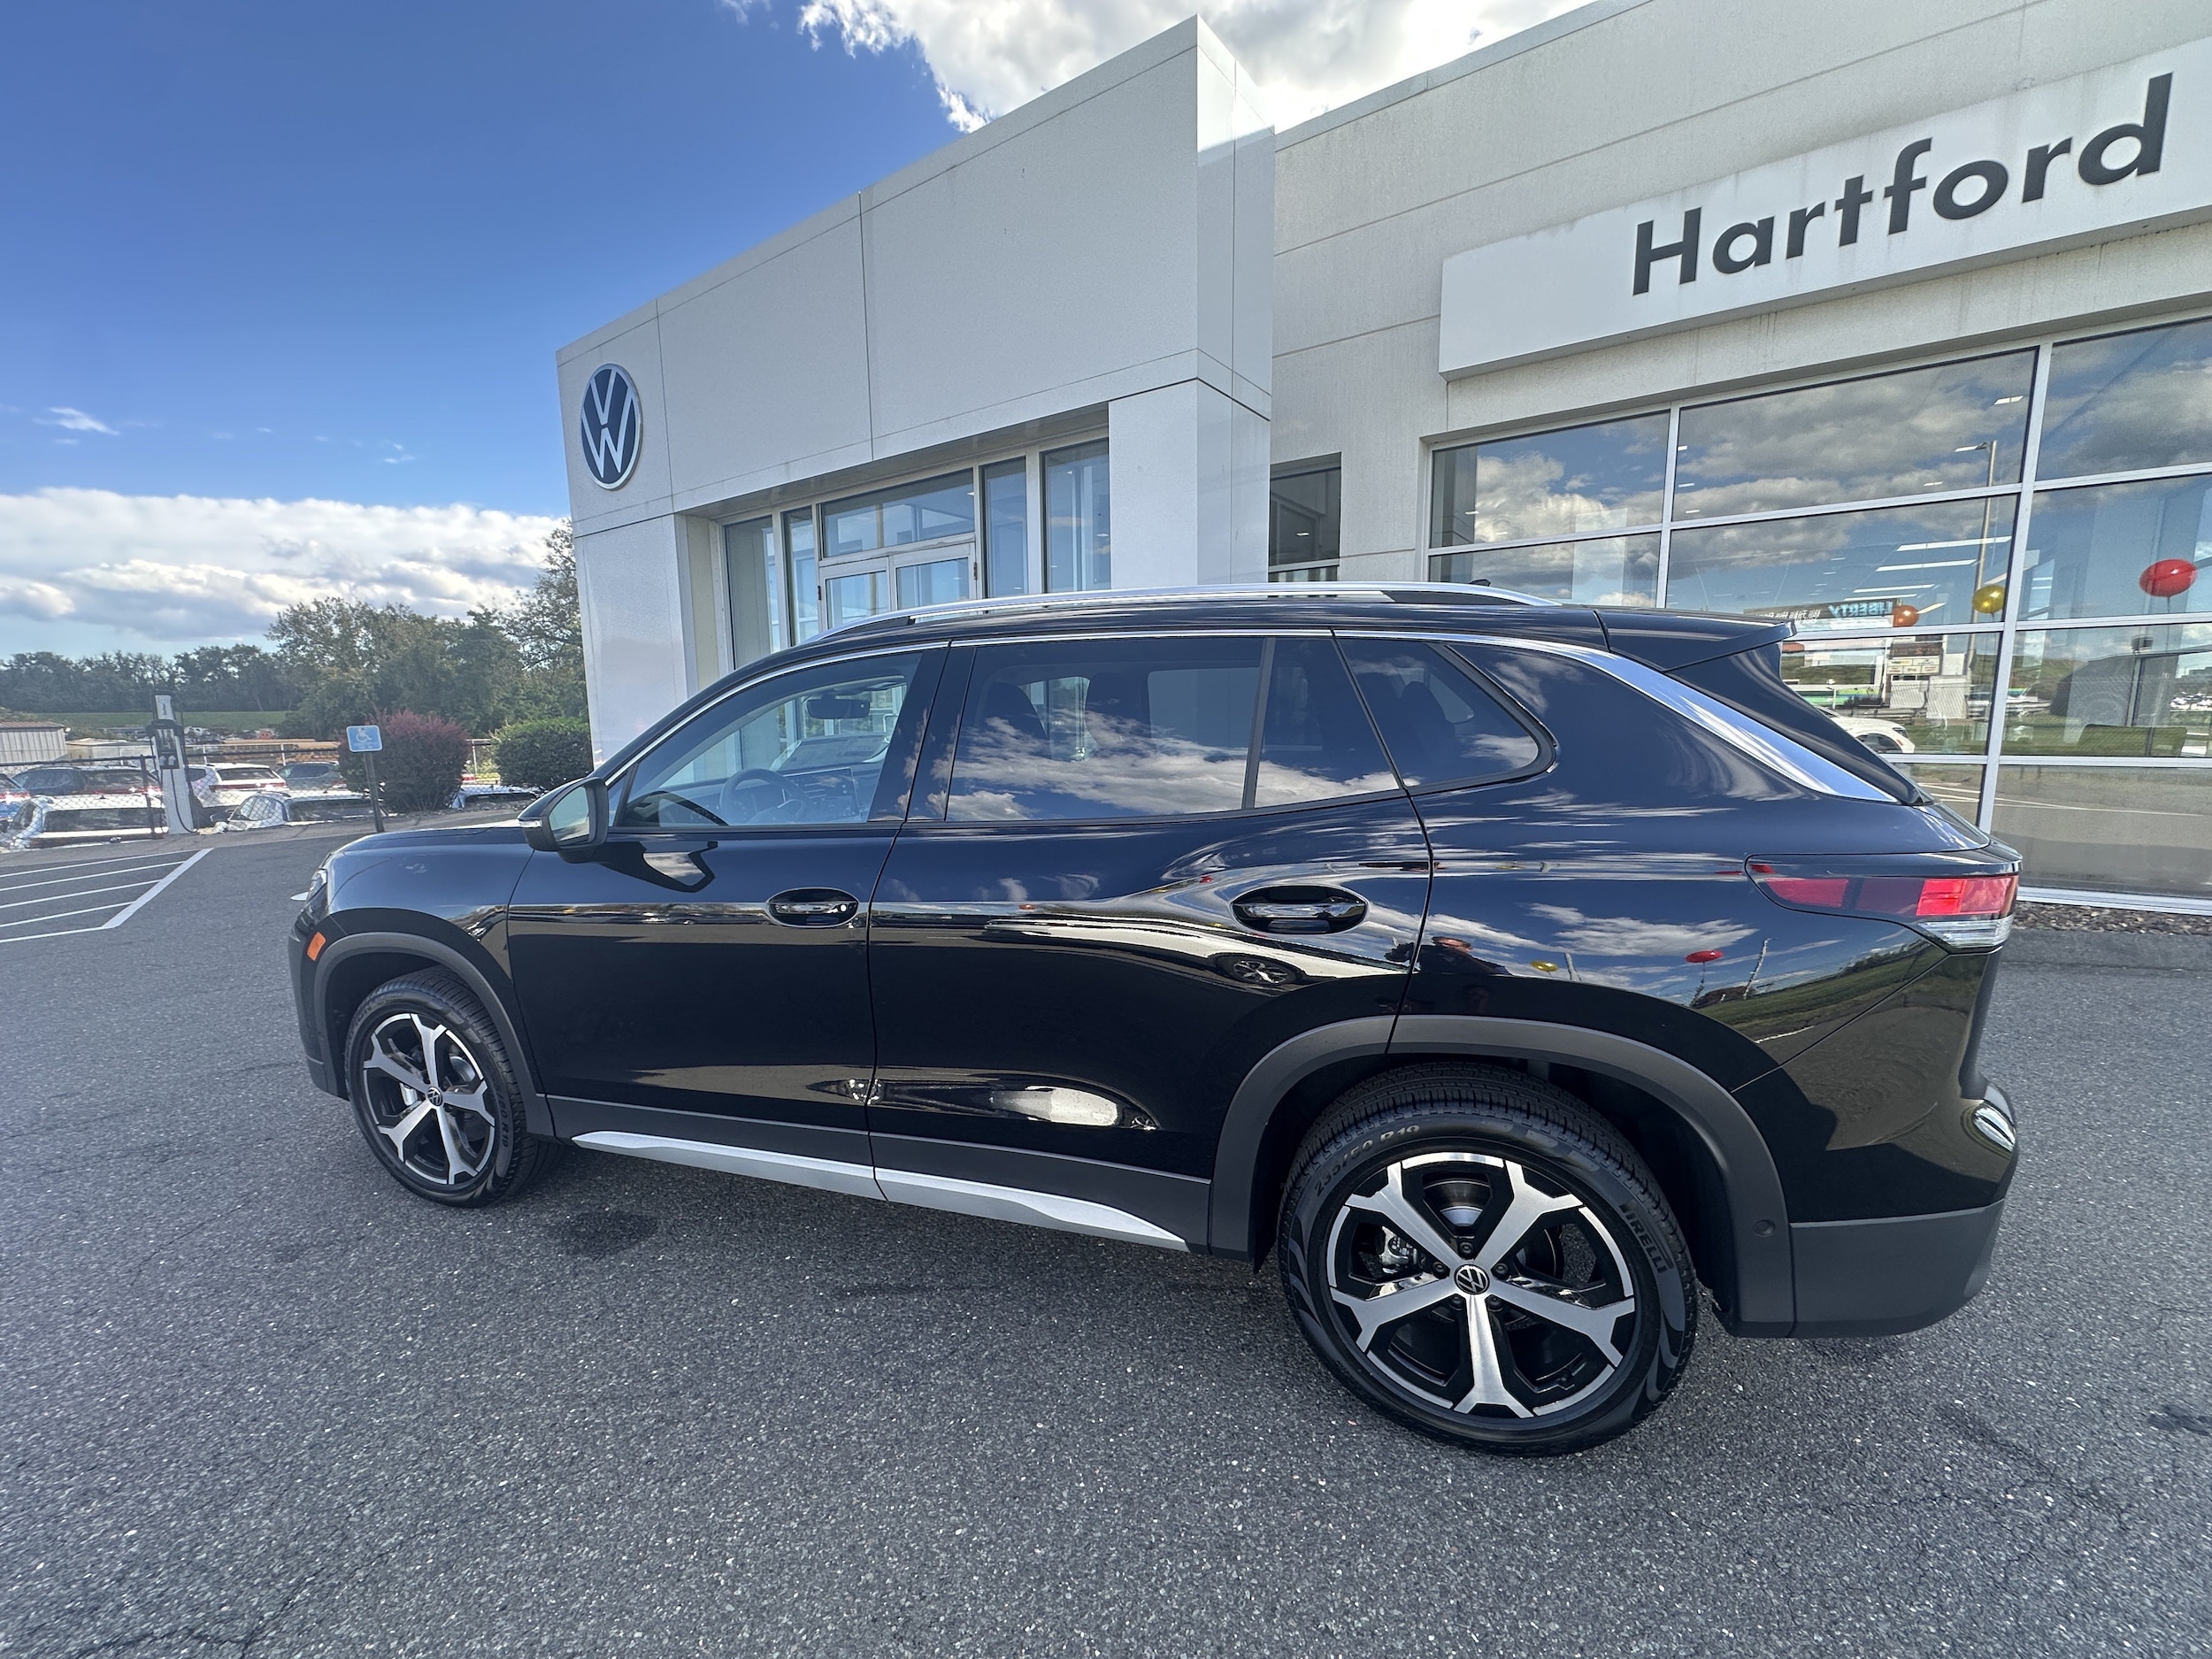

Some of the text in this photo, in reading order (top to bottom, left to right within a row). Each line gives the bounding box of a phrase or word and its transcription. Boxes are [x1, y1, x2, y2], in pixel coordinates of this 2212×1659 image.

[1632, 72, 2174, 296] Hartford
[581, 364, 642, 490] VW
[1455, 1264, 1489, 1294] VW
[1618, 1202, 1674, 1273] PIRELLI
